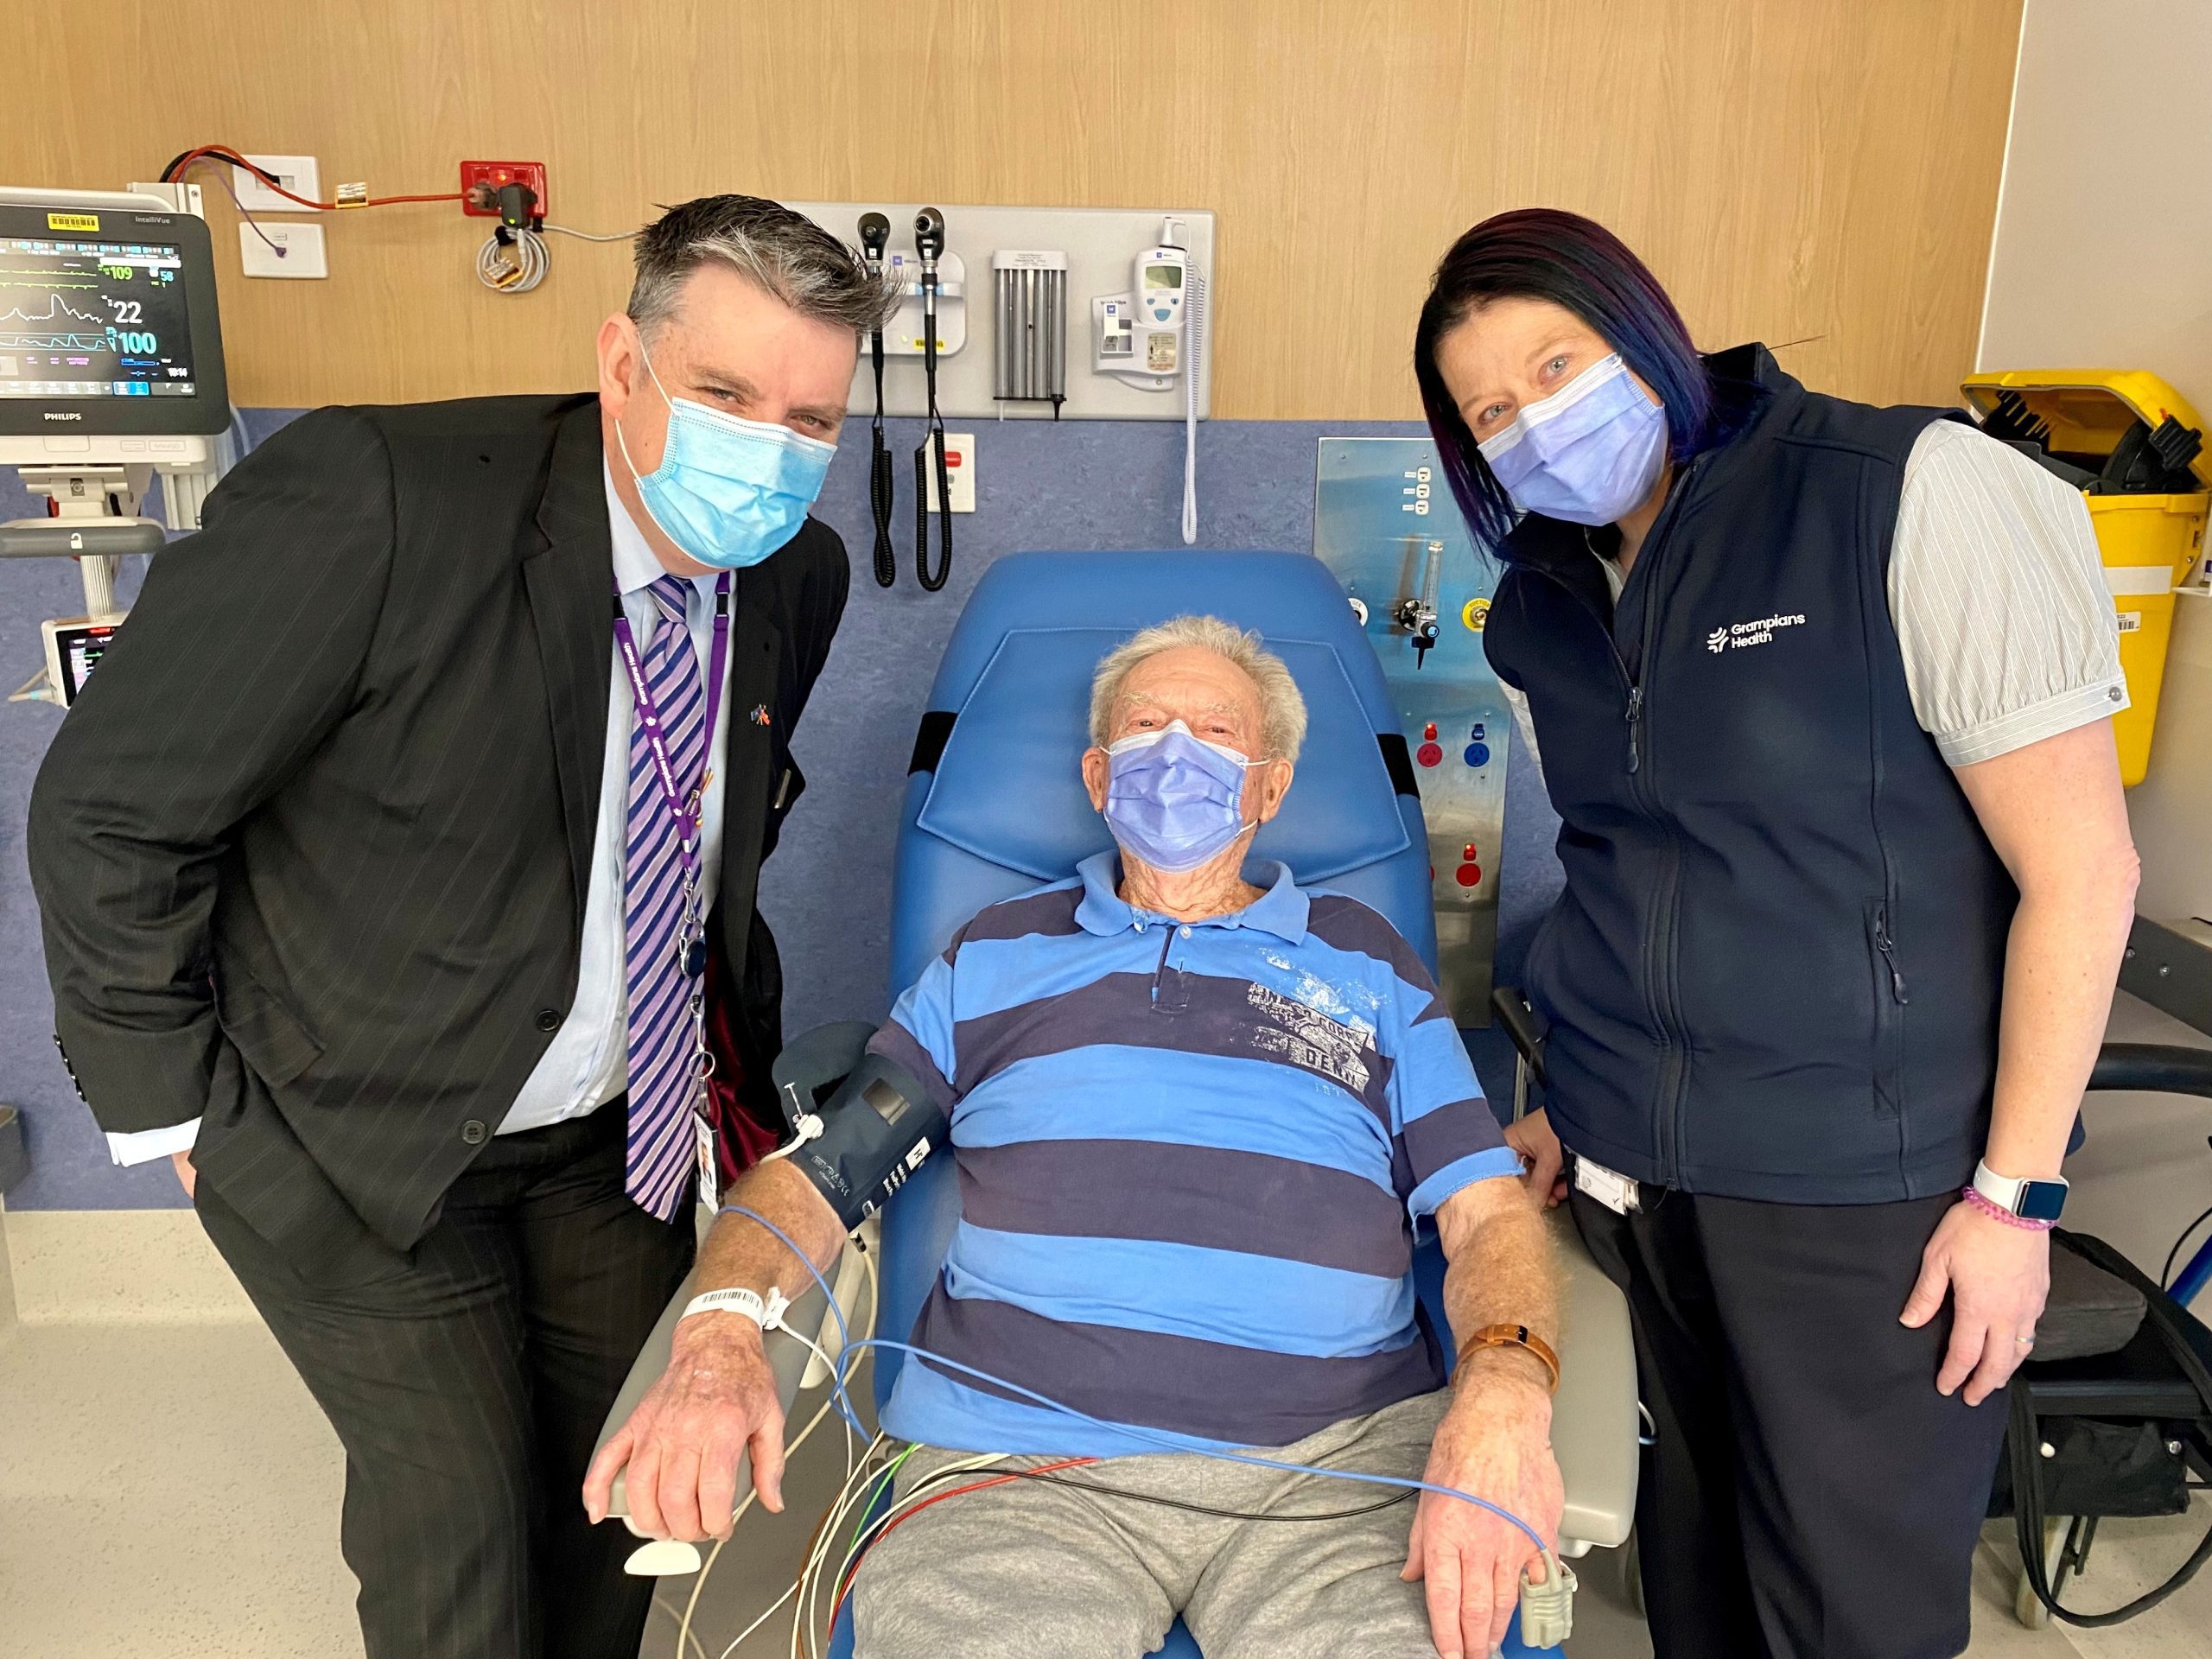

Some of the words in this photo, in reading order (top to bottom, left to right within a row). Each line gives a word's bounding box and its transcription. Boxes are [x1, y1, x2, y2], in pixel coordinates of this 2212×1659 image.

[135, 215, 171, 225] IntelliVue
[110, 266, 133, 281] 109
[160, 270, 175, 283] 58
[113, 301, 143, 324] 22
[118, 332, 157, 355] 100
[43, 412, 82, 422] PHILIPS
[1731, 613, 1806, 635] Grampians
[1731, 631, 1773, 649] Health
[624, 642, 637, 666] Health
[631, 666, 649, 706] Grampians
[652, 736, 664, 760] Health
[660, 760, 676, 798] Grampians
